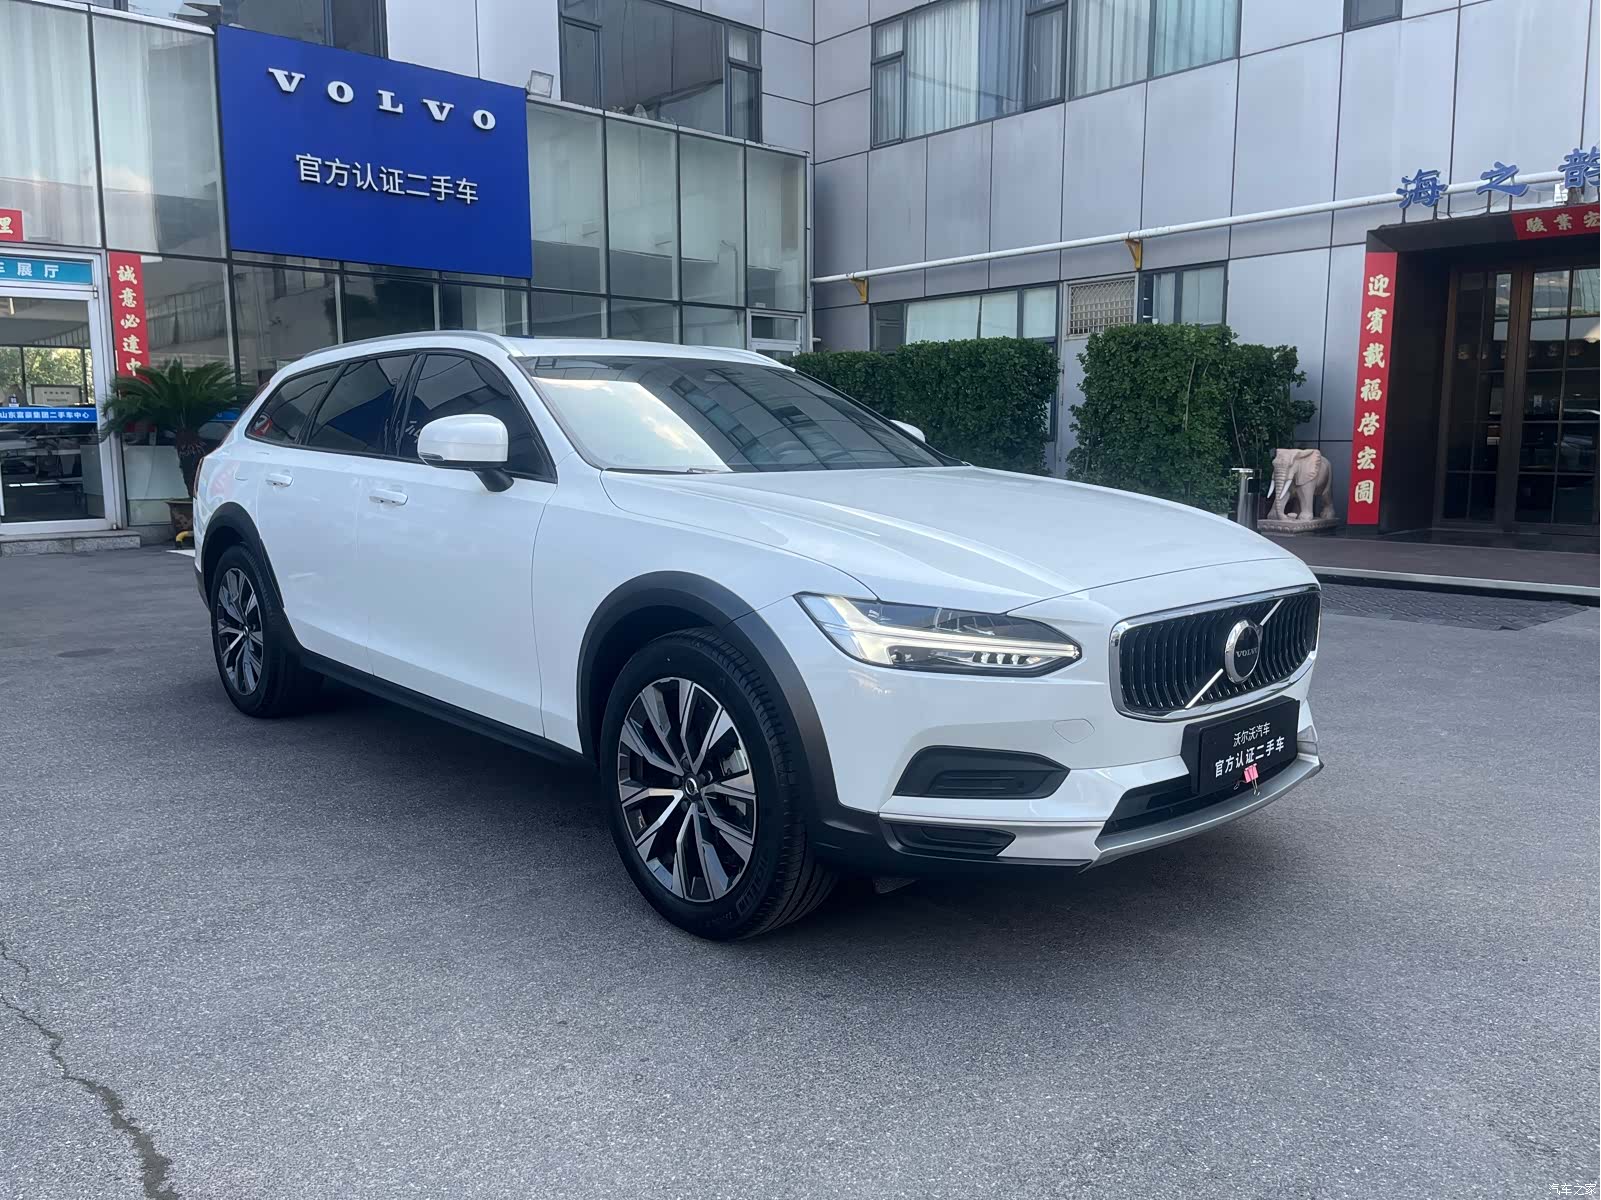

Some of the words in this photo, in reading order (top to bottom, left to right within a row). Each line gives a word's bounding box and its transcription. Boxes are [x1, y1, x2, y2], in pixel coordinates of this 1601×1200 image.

[268, 67, 496, 130] VOLVO
[295, 153, 479, 204] 官方认证二手车
[1215, 736, 1285, 778] 官方认证二手车
[1233, 722, 1271, 747] 沃尔沃汽车
